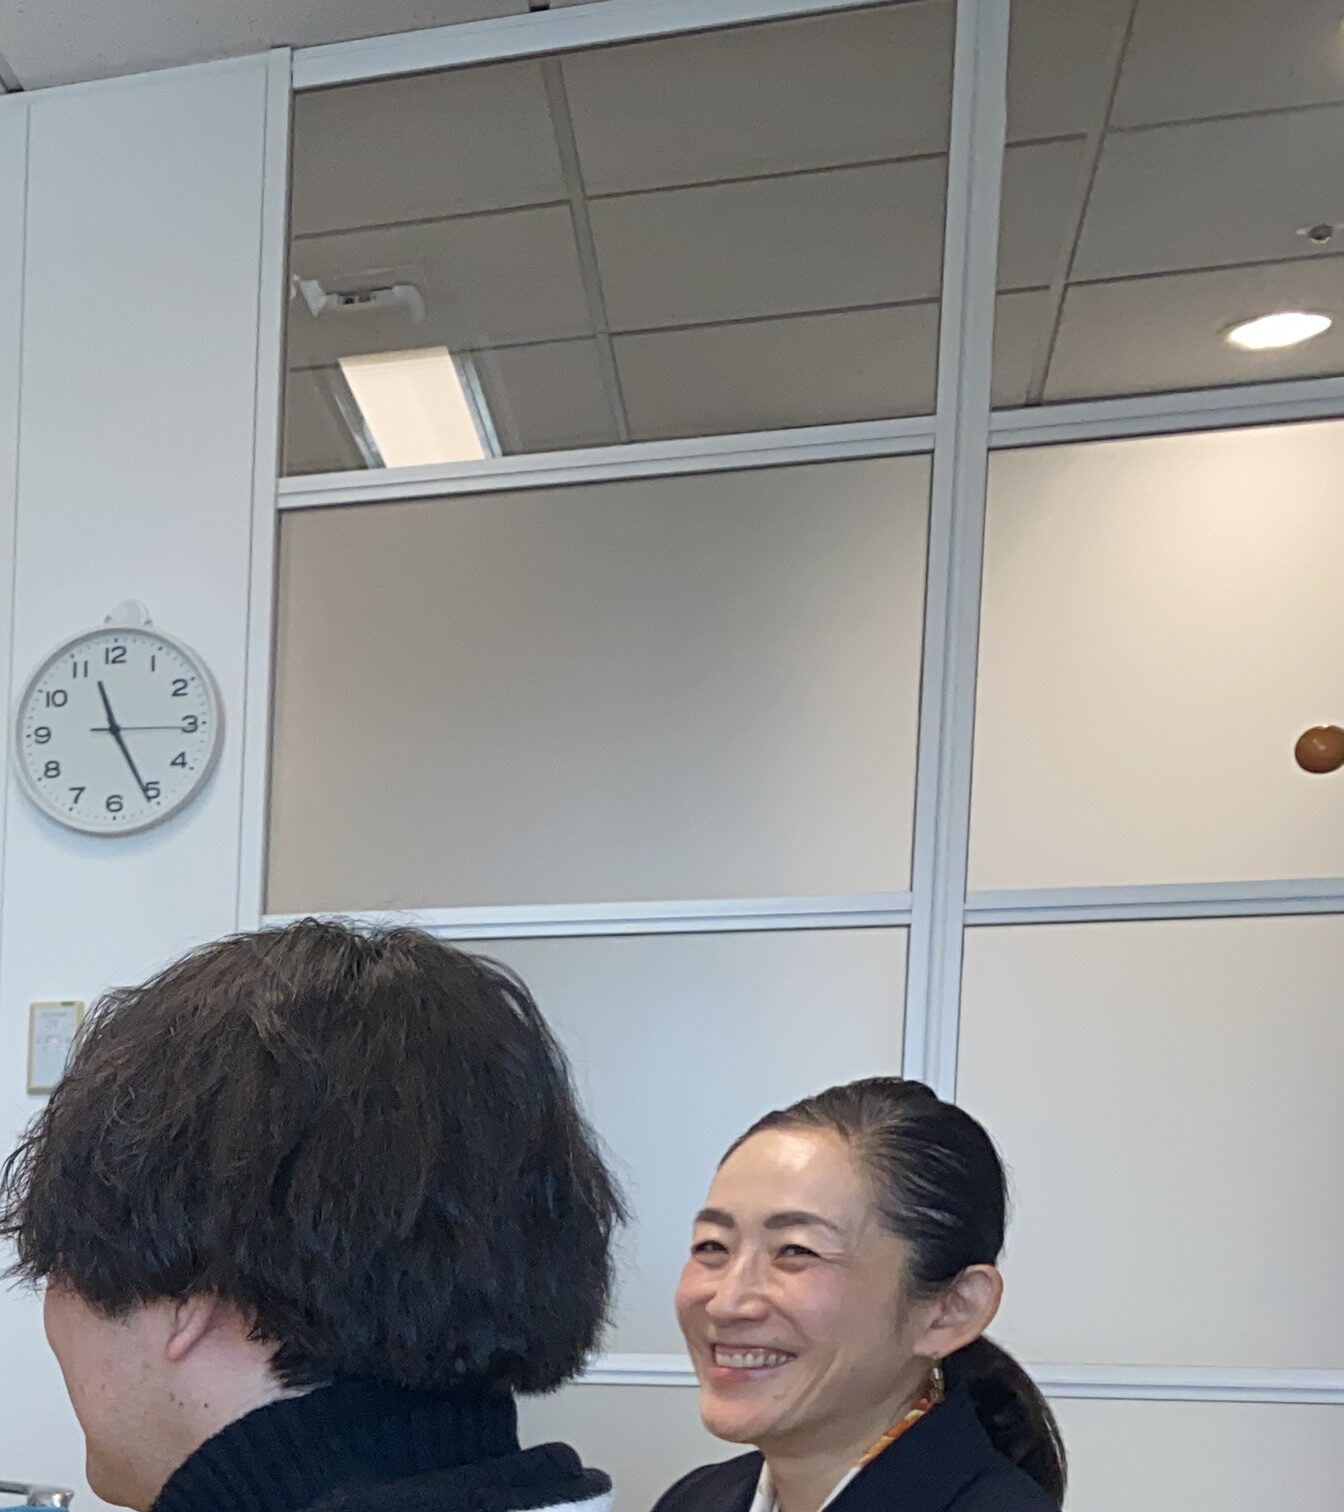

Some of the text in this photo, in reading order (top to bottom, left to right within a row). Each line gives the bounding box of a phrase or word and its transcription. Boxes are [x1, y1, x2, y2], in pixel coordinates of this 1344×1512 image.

[104, 645, 128, 665] 12
[150, 655, 156, 672] 1
[72, 660, 89, 679] 11
[171, 678, 189, 697] 2
[45, 689, 69, 708] 10
[180, 714, 199, 734] 3
[33, 725, 52, 745] 9
[43, 759, 62, 779] 8
[169, 751, 188, 769] 4
[68, 786, 87, 805] 7
[144, 781, 161, 800] 5
[105, 794, 124, 813] 6
